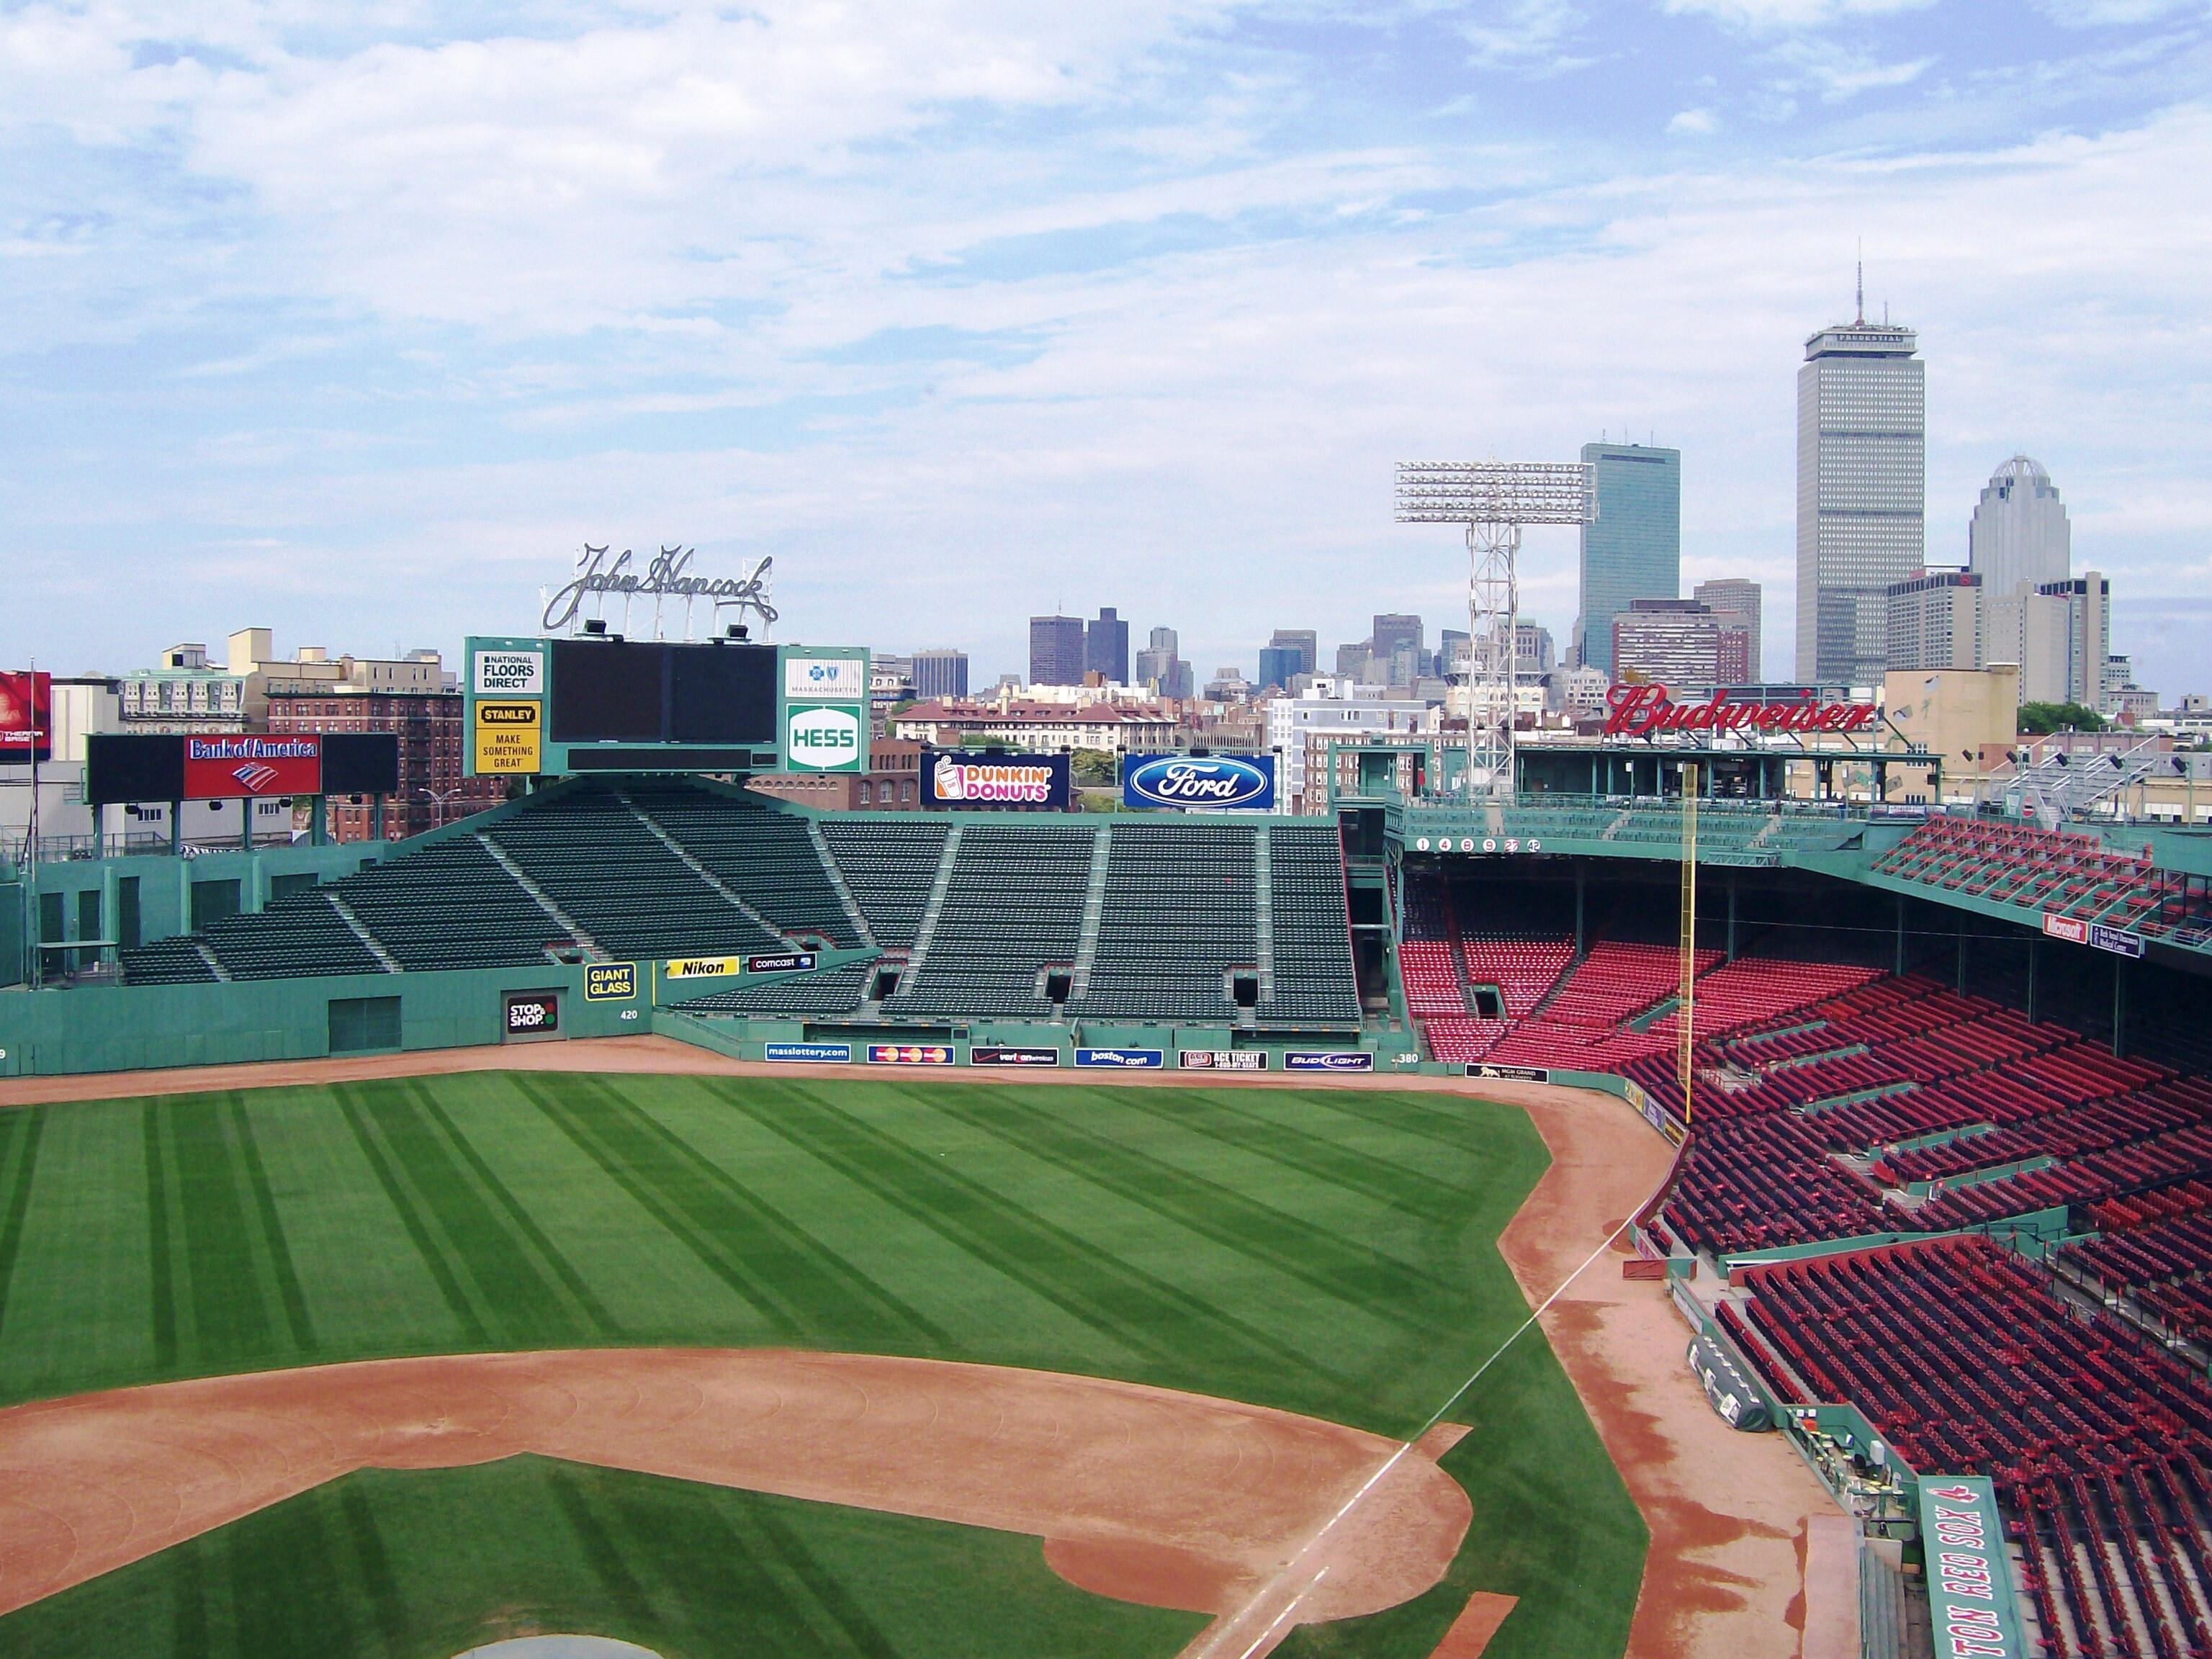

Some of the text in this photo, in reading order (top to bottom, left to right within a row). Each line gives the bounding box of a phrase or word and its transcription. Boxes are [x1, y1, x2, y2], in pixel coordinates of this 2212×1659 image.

[542, 542, 778, 630] John Hancock
[484, 665, 534, 676] FLOORS
[484, 678, 528, 688] DIRECT
[485, 710, 532, 719] STANLEY
[1606, 683, 1876, 736] Budweiser
[496, 734, 521, 744] MAKE
[793, 729, 854, 747] HESS
[190, 738, 317, 759] Bank of America
[483, 747, 533, 756] SOMETHING
[494, 758, 521, 768] GREAT
[966, 767, 1051, 783] DUNKIN'
[1158, 763, 1240, 797] Ford
[966, 783, 1046, 799] DONUTS
[1505, 841, 1519, 851] 27
[1528, 841, 1539, 851] 42
[682, 962, 724, 975] Nikon
[755, 958, 795, 968] comcast
[590, 969, 630, 981] GIANT
[590, 981, 631, 994] GLASS
[620, 1010, 638, 1020] 420
[768, 1047, 848, 1058] masslottery.com
[1214, 1053, 1260, 1063] ACE TICKET
[1091, 1052, 1147, 1065] boston.com
[1399, 1053, 1419, 1064] 380
[1935, 1505, 2006, 1659] TON RED SOX
